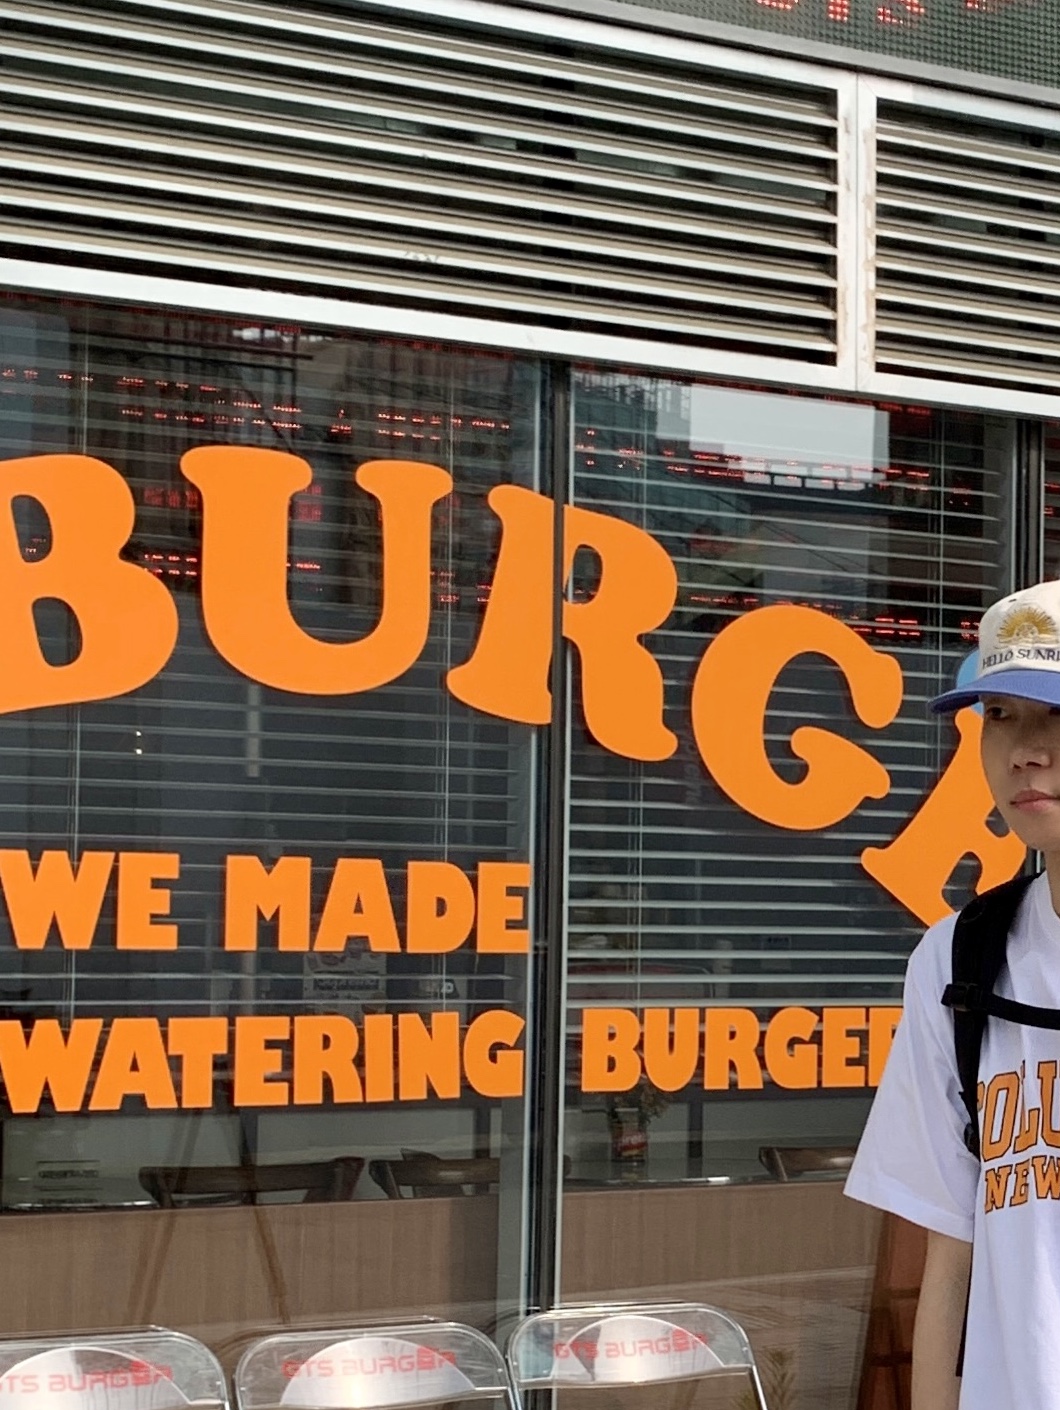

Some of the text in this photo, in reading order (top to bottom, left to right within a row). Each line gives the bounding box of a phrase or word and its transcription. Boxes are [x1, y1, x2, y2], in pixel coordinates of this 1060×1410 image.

[982, 650, 1013, 669] HELLO
[0, 849, 530, 954] WE MADE
[0, 1009, 525, 1113] WATERING
[0, 1374, 39, 1394] TS
